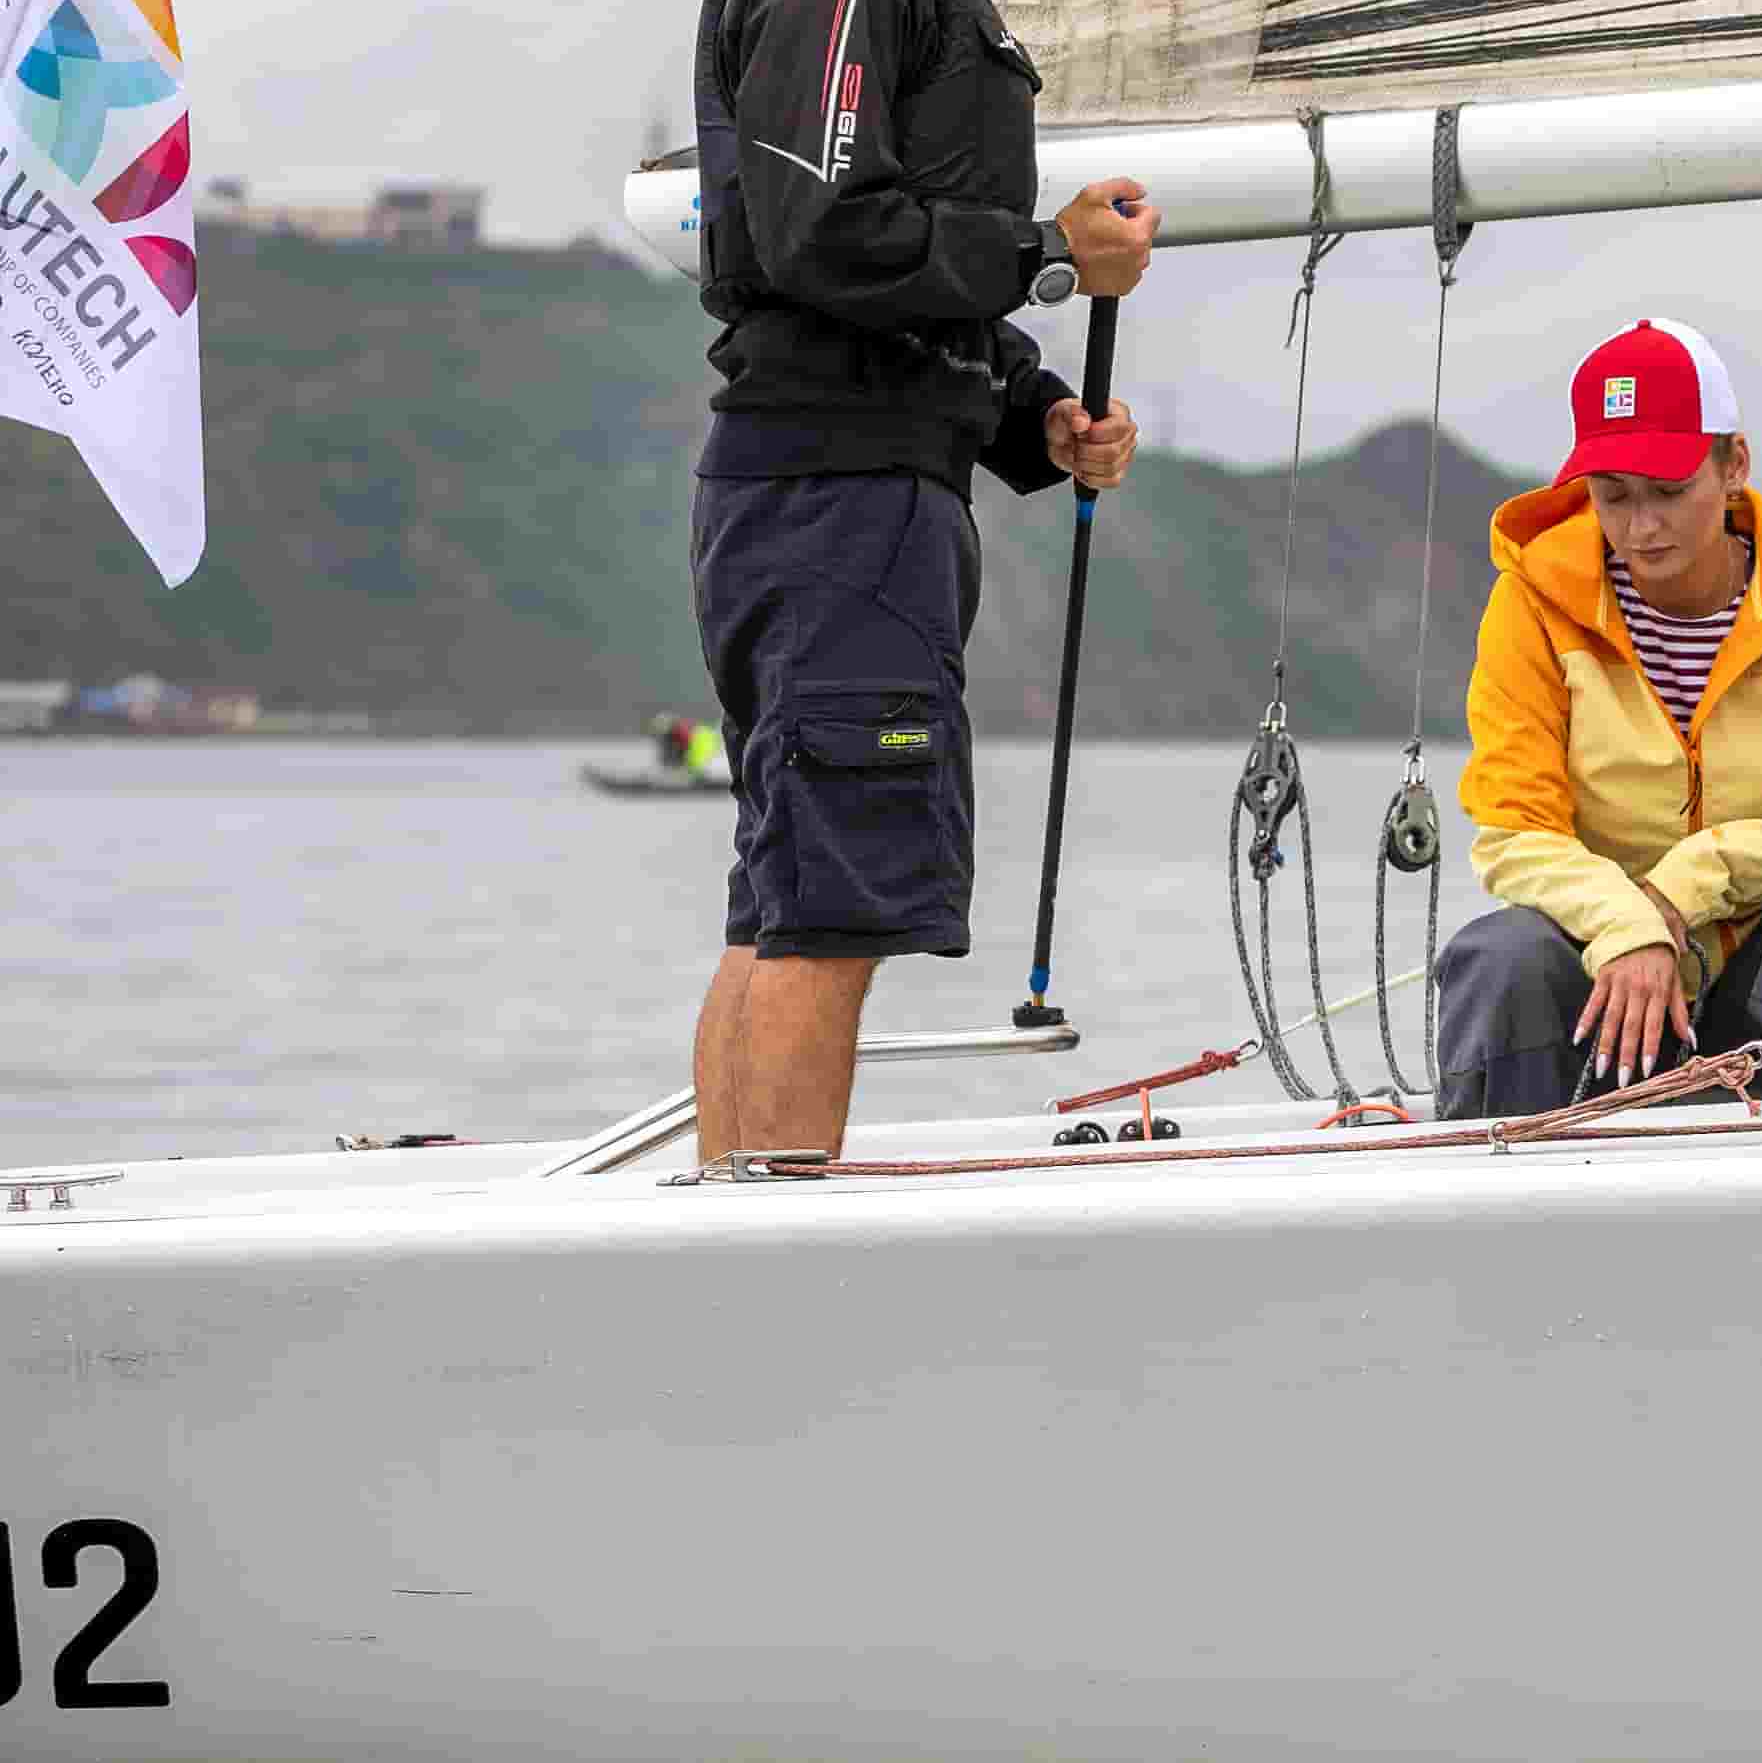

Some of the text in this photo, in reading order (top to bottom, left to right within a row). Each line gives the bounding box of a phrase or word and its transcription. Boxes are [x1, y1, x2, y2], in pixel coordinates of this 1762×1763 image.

[0, 147, 157, 372] UTECH
[34, 295, 107, 390] COMPANIES
[0, 1517, 171, 1709] 2
